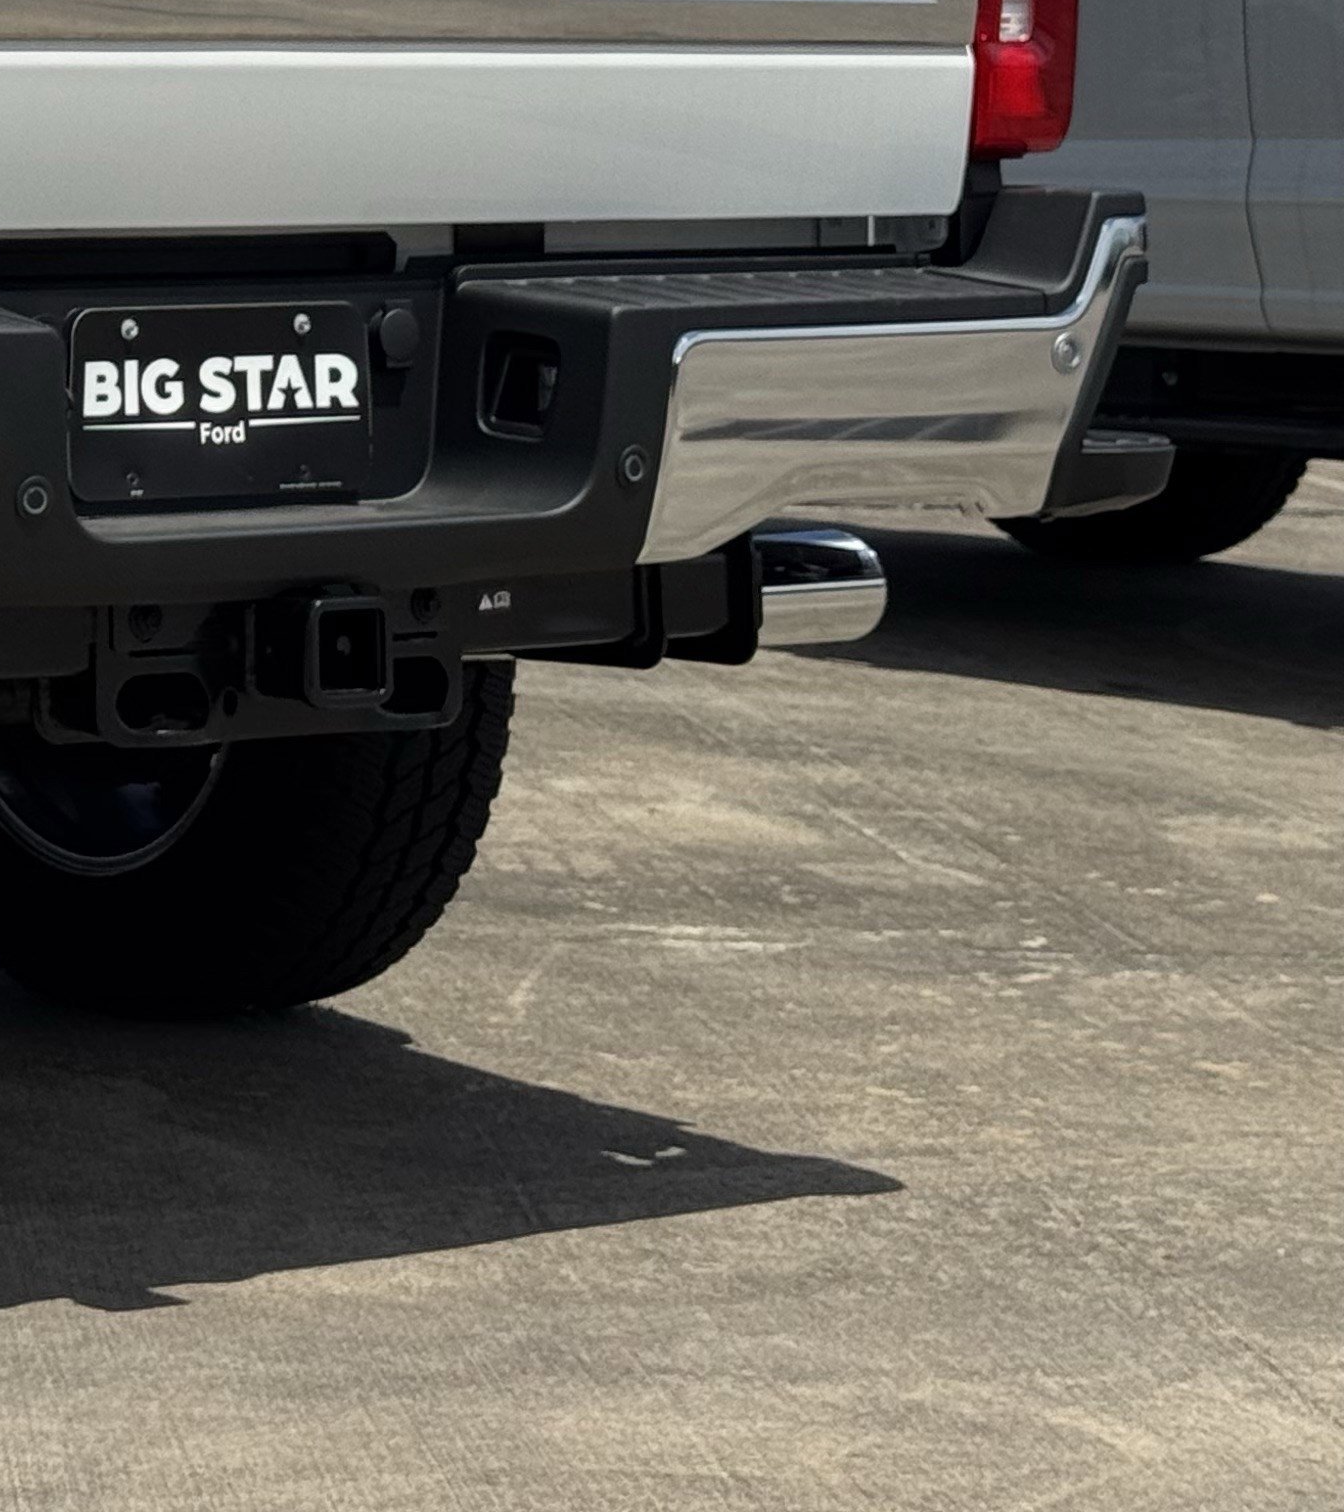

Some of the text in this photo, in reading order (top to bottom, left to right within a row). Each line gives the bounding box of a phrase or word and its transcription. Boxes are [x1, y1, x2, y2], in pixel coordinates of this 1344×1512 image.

[82, 353, 360, 418] BIG STAR
[199, 420, 247, 446] Ford
